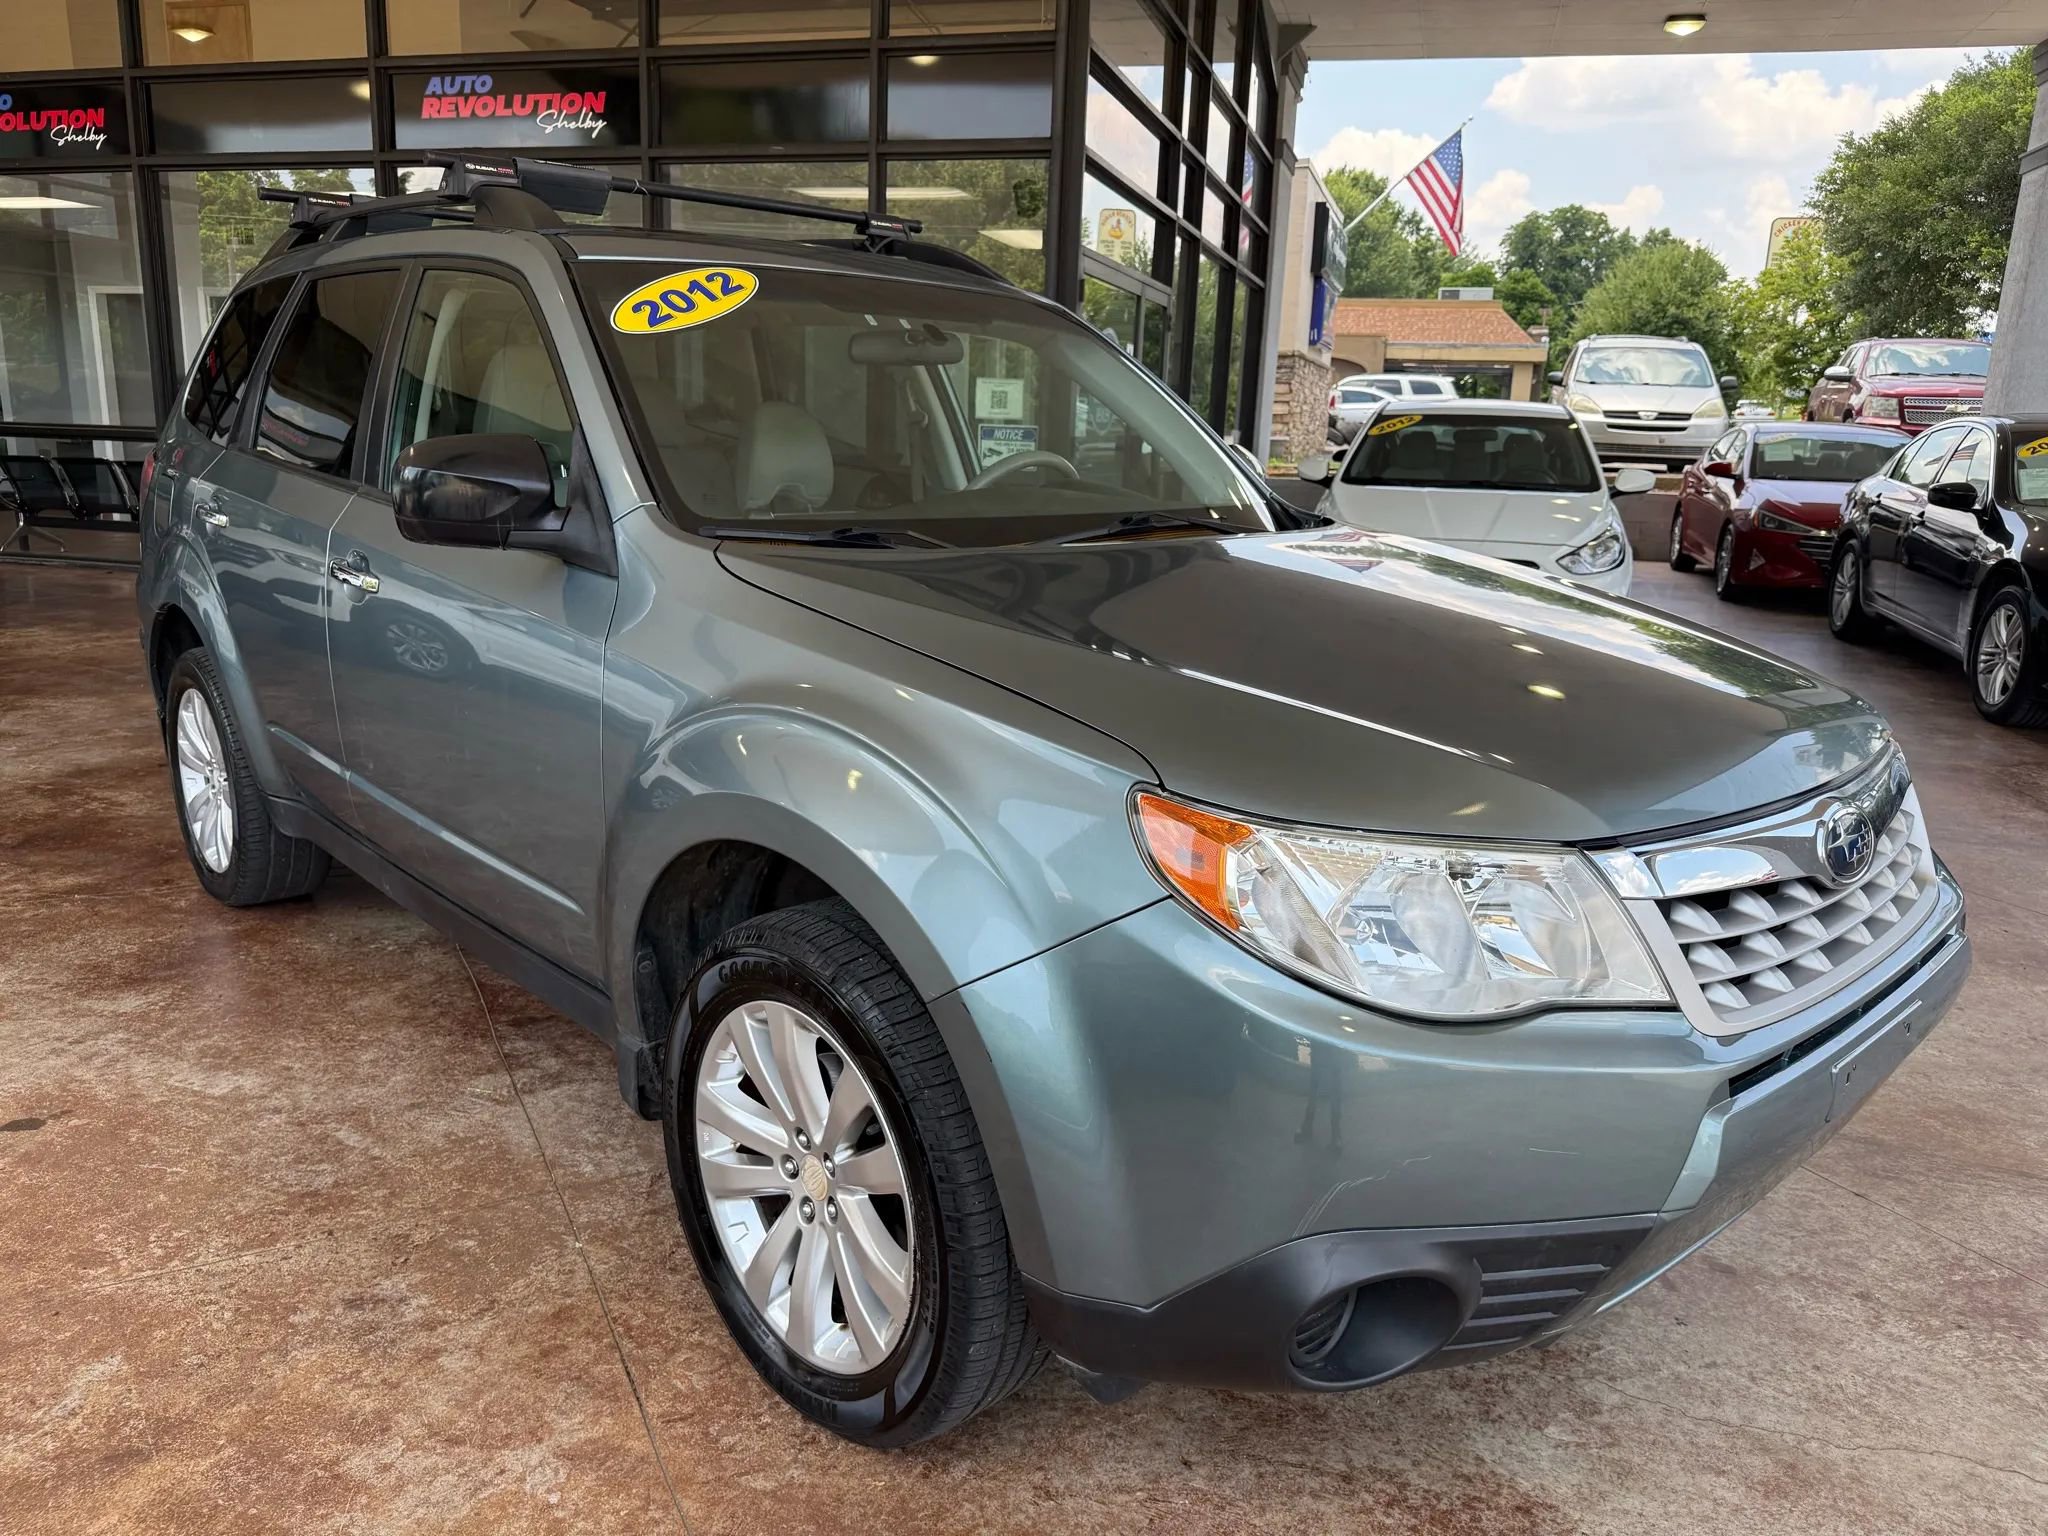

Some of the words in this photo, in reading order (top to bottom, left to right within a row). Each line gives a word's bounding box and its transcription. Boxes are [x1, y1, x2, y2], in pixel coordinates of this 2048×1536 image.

[424, 74, 493, 95] AUTO
[421, 91, 607, 119] REVOLUTION
[50, 122, 107, 150] Shelby
[536, 107, 607, 139] Shelby
[631, 271, 747, 329] 2012
[993, 428, 1025, 441] NOTICE
[1375, 416, 1417, 432] 2012
